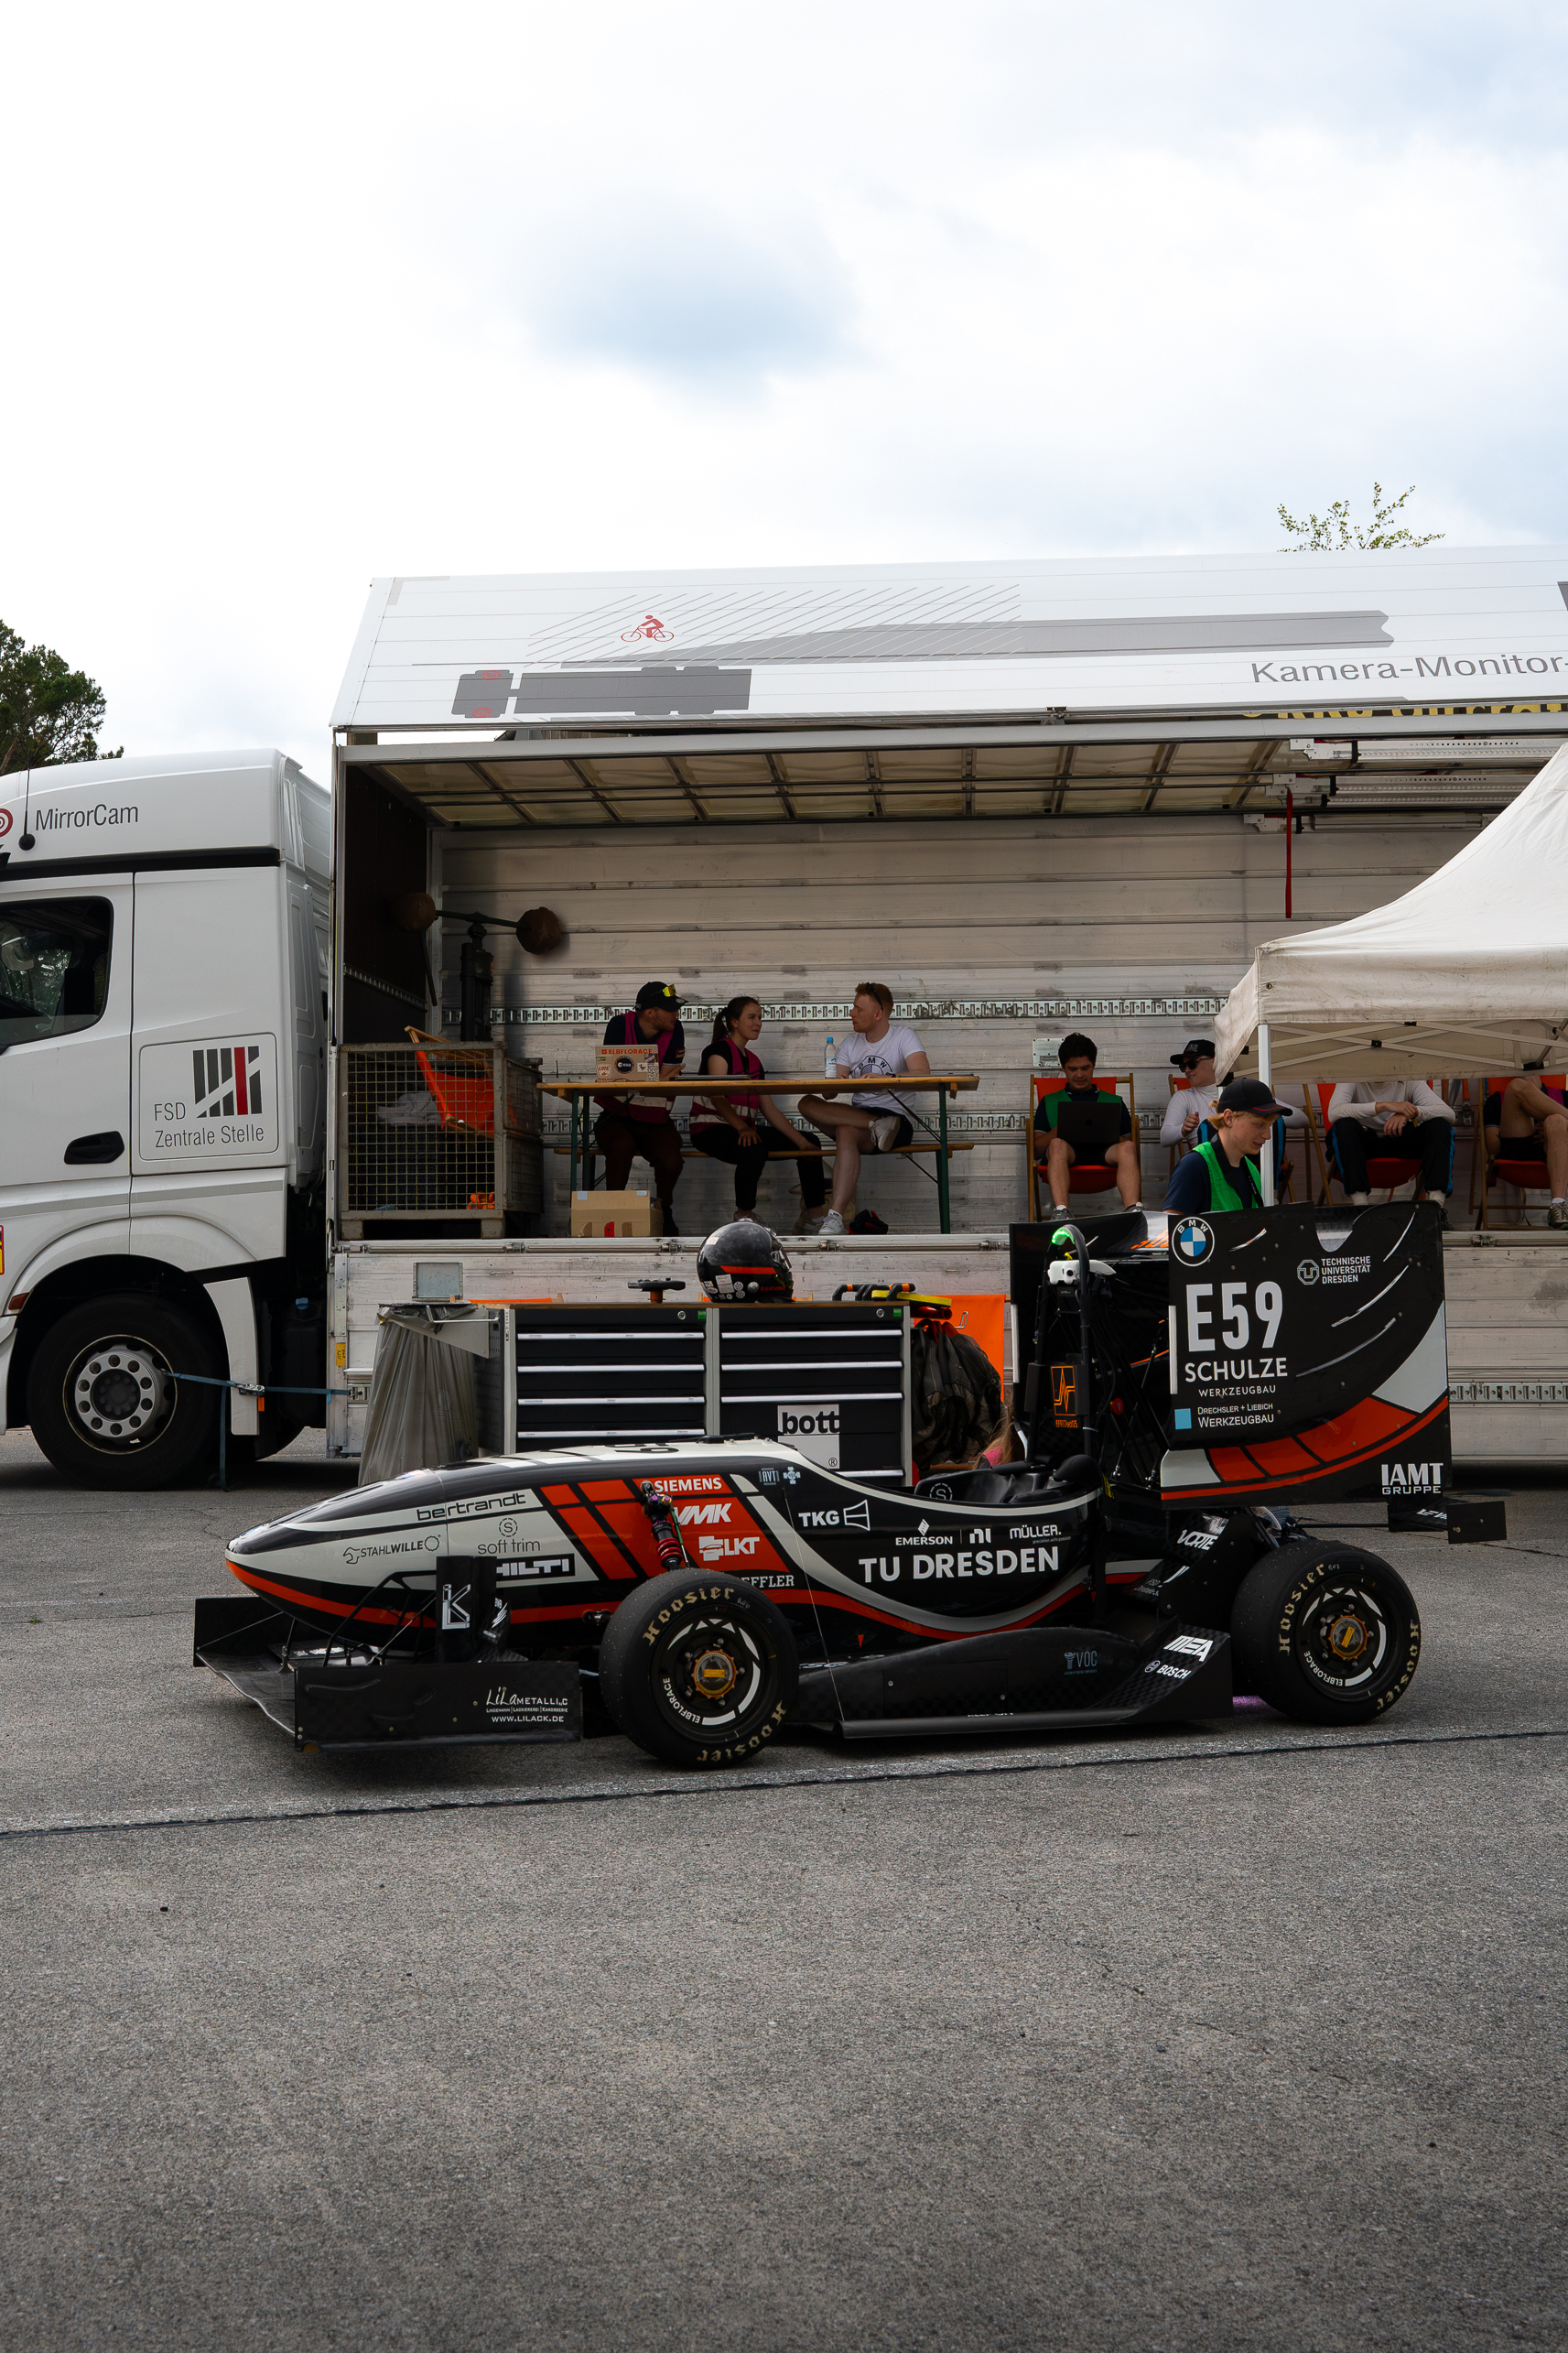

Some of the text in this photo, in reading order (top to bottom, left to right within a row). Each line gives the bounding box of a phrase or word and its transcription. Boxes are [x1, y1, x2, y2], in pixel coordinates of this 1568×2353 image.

[36, 803, 138, 831] MirrorCam
[154, 1101, 186, 1122] FSD
[155, 1123, 265, 1148] Zentrale Stelle
[1177, 1219, 1209, 1234] BMW
[1321, 1255, 1371, 1266] TECHNISCHE
[1321, 1264, 1371, 1275] UNIVERSITÄT
[1322, 1274, 1358, 1285] DRESDEN
[1185, 1281, 1282, 1352] E59
[1184, 1357, 1288, 1383] SCHULZE
[1198, 1384, 1276, 1397] WERKZEUGBAU
[782, 1411, 840, 1435] bott
[762, 1469, 777, 1482] AVT
[1381, 1462, 1444, 1486] IAMT
[654, 1477, 722, 1493] SIEMENS
[1382, 1485, 1442, 1495] GRUPPE
[416, 1492, 526, 1522] bertrandt
[798, 1510, 840, 1527] TKG
[360, 1539, 424, 1558] STAHLWILLE
[477, 1538, 541, 1555] soft trim
[724, 1536, 761, 1556] LKT
[895, 1535, 954, 1546] EMERSON
[1177, 1529, 1219, 1551] VORTE
[496, 1558, 569, 1577] HILTI
[859, 1545, 1059, 1583] TU DRESDEN
[1156, 1664, 1192, 1679] BOSCH
[1303, 1650, 1344, 1686] ELBFLORACE
[662, 1677, 701, 1724] ELBFLORACE
[491, 1715, 565, 1723] WWW.LILACK.DE
